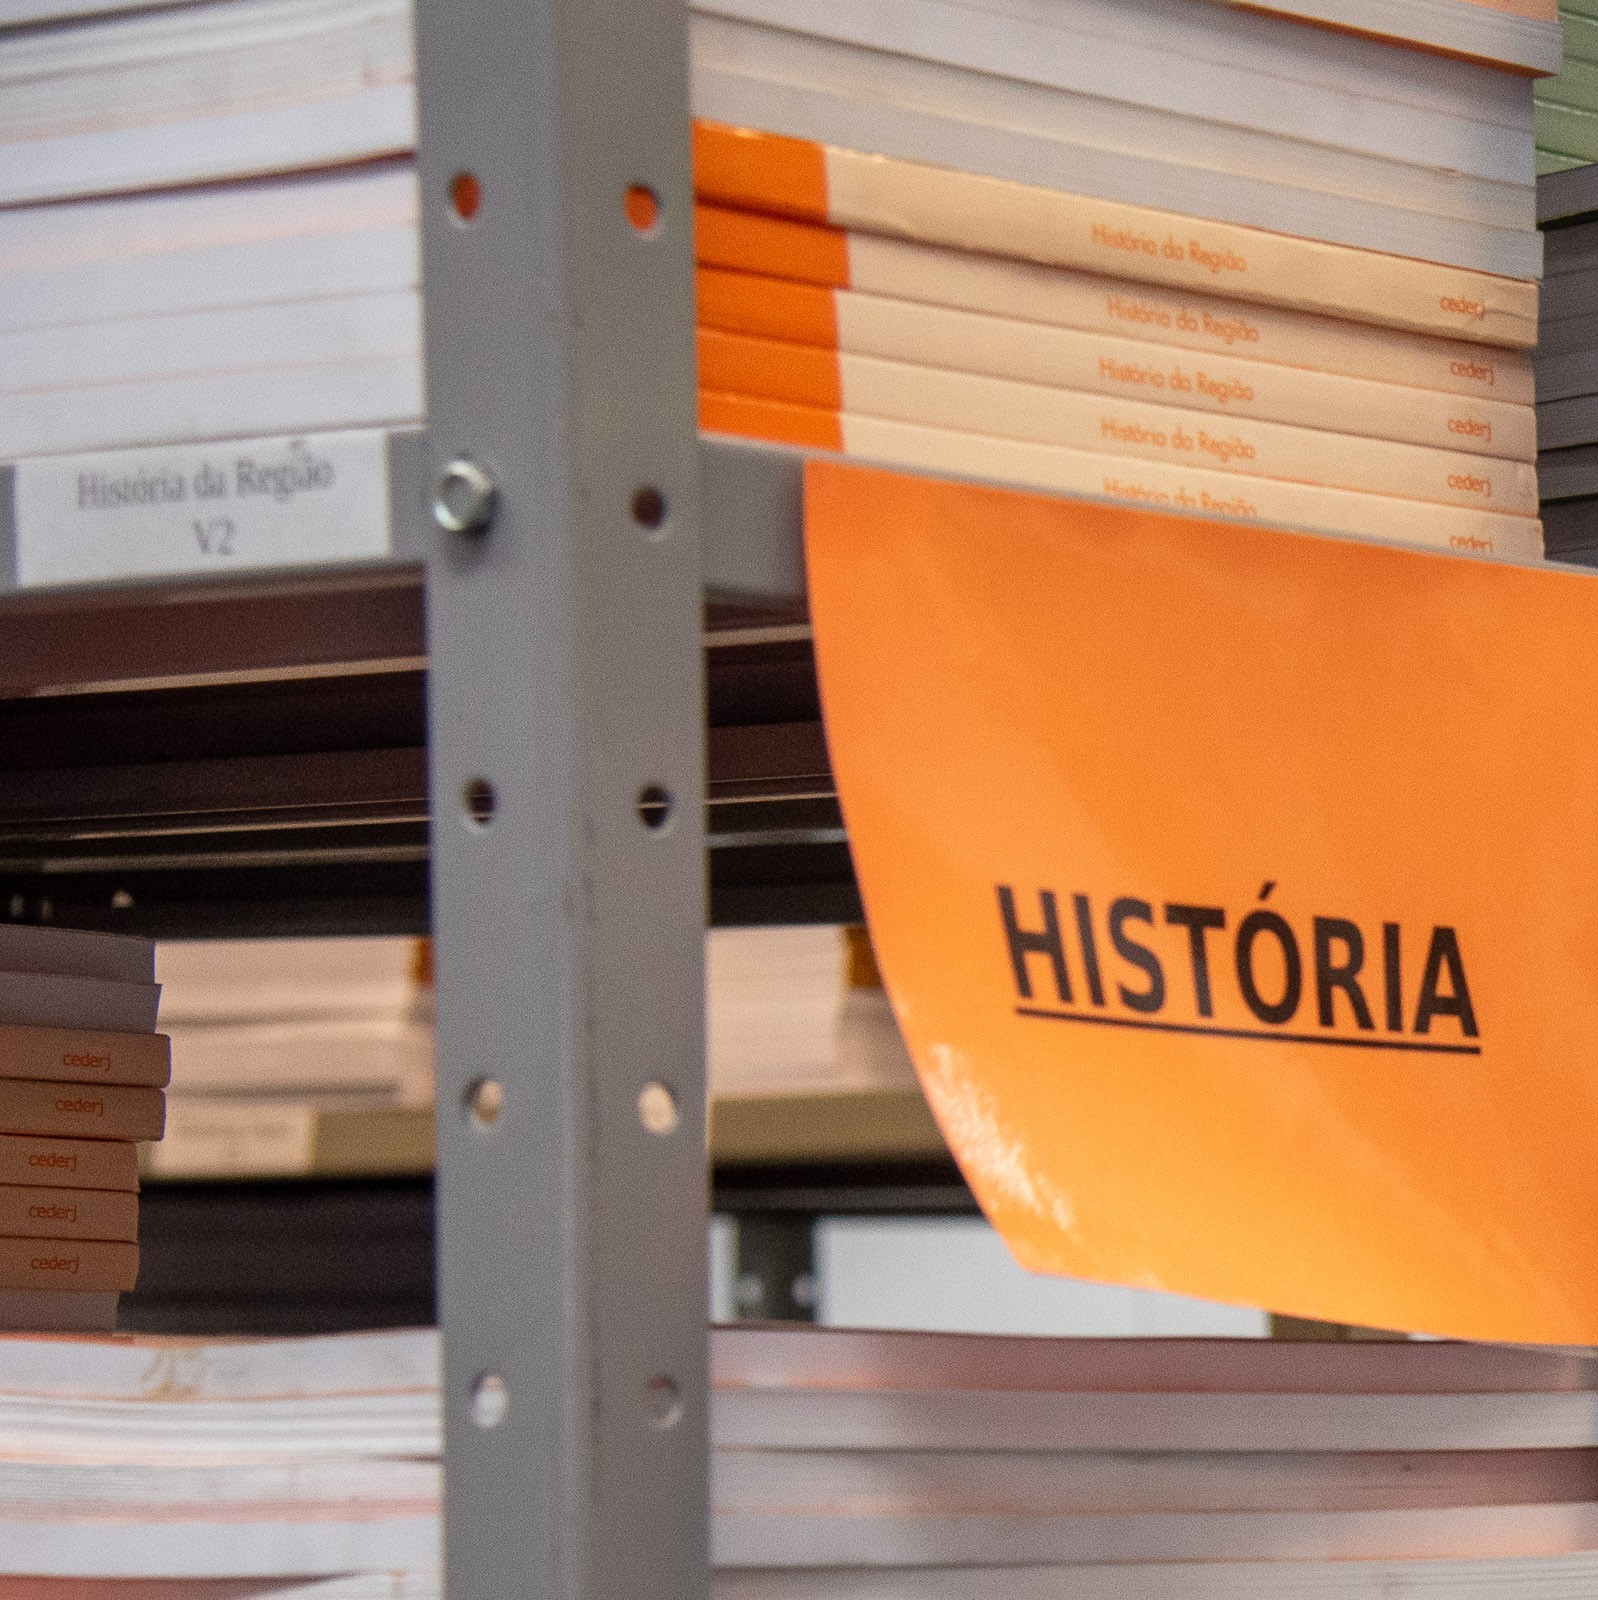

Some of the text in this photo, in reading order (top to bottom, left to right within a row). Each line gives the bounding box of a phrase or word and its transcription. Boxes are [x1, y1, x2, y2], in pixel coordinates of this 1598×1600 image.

[1440, 296, 1486, 321] cederj
[1450, 361, 1494, 385] cederj
[1447, 419, 1492, 443] cederj
[1447, 472, 1492, 497] cederj
[193, 518, 235, 556] V2
[994, 881, 1480, 1038] HISTÓRIA
[62, 1051, 112, 1072] cederj
[55, 1096, 104, 1117] cederj
[28, 1151, 77, 1170] cederj
[28, 1203, 77, 1222] cederj
[30, 1255, 80, 1275] cederj
